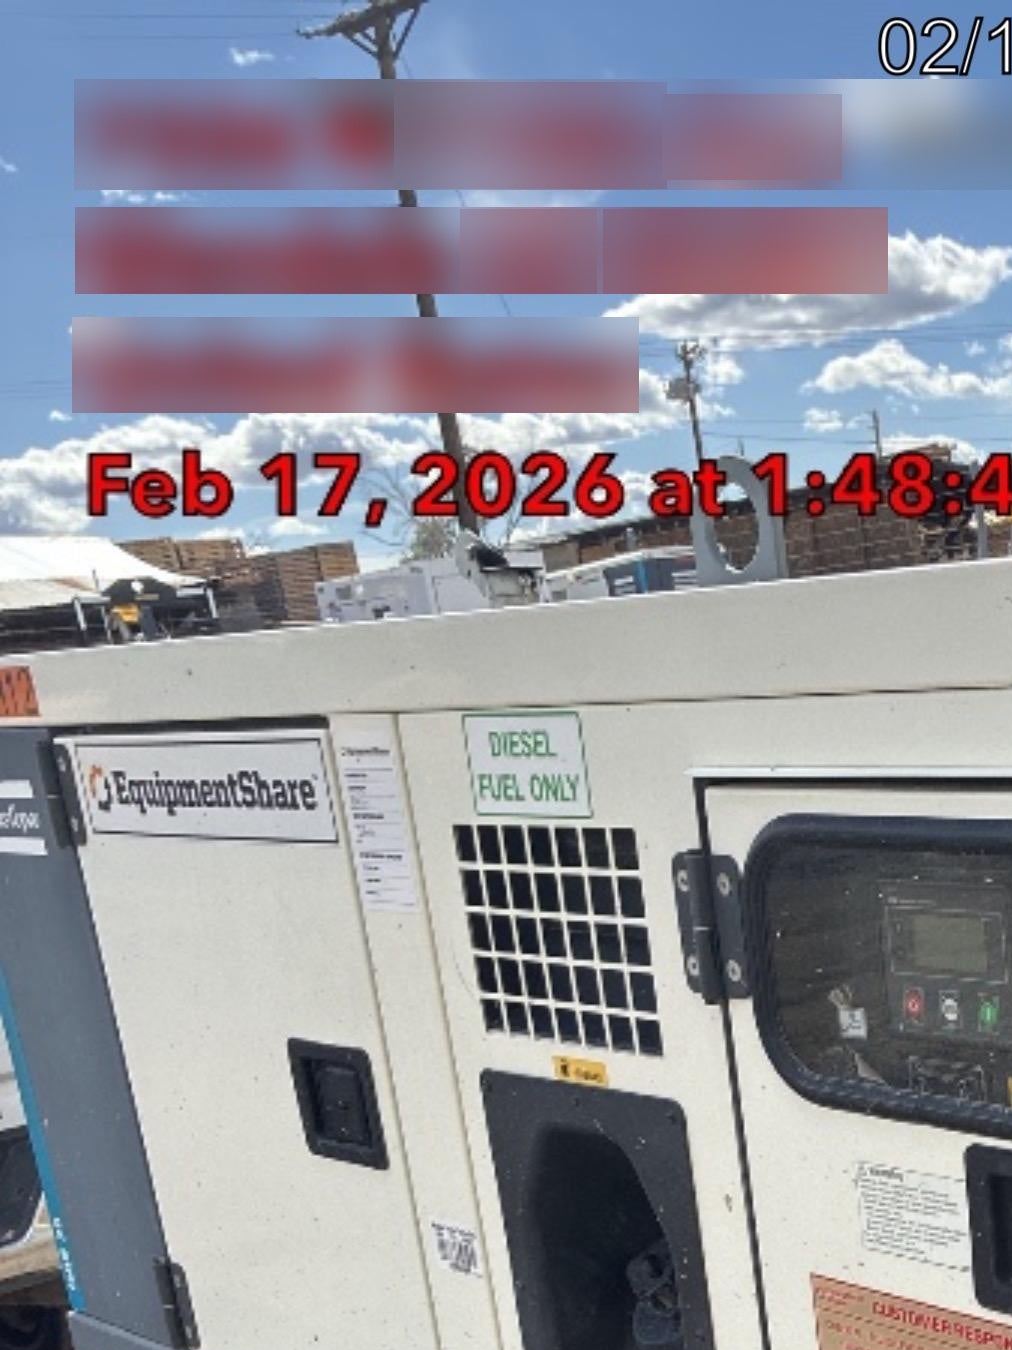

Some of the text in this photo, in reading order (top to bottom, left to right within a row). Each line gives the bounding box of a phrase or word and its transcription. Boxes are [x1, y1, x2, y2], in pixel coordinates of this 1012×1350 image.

[488, 730, 558, 758] DIESEL
[110, 770, 319, 816] EquipmentShare
[477, 773, 580, 802] FUEL ONLY
[872, 1301, 951, 1336] CUSTOMER
